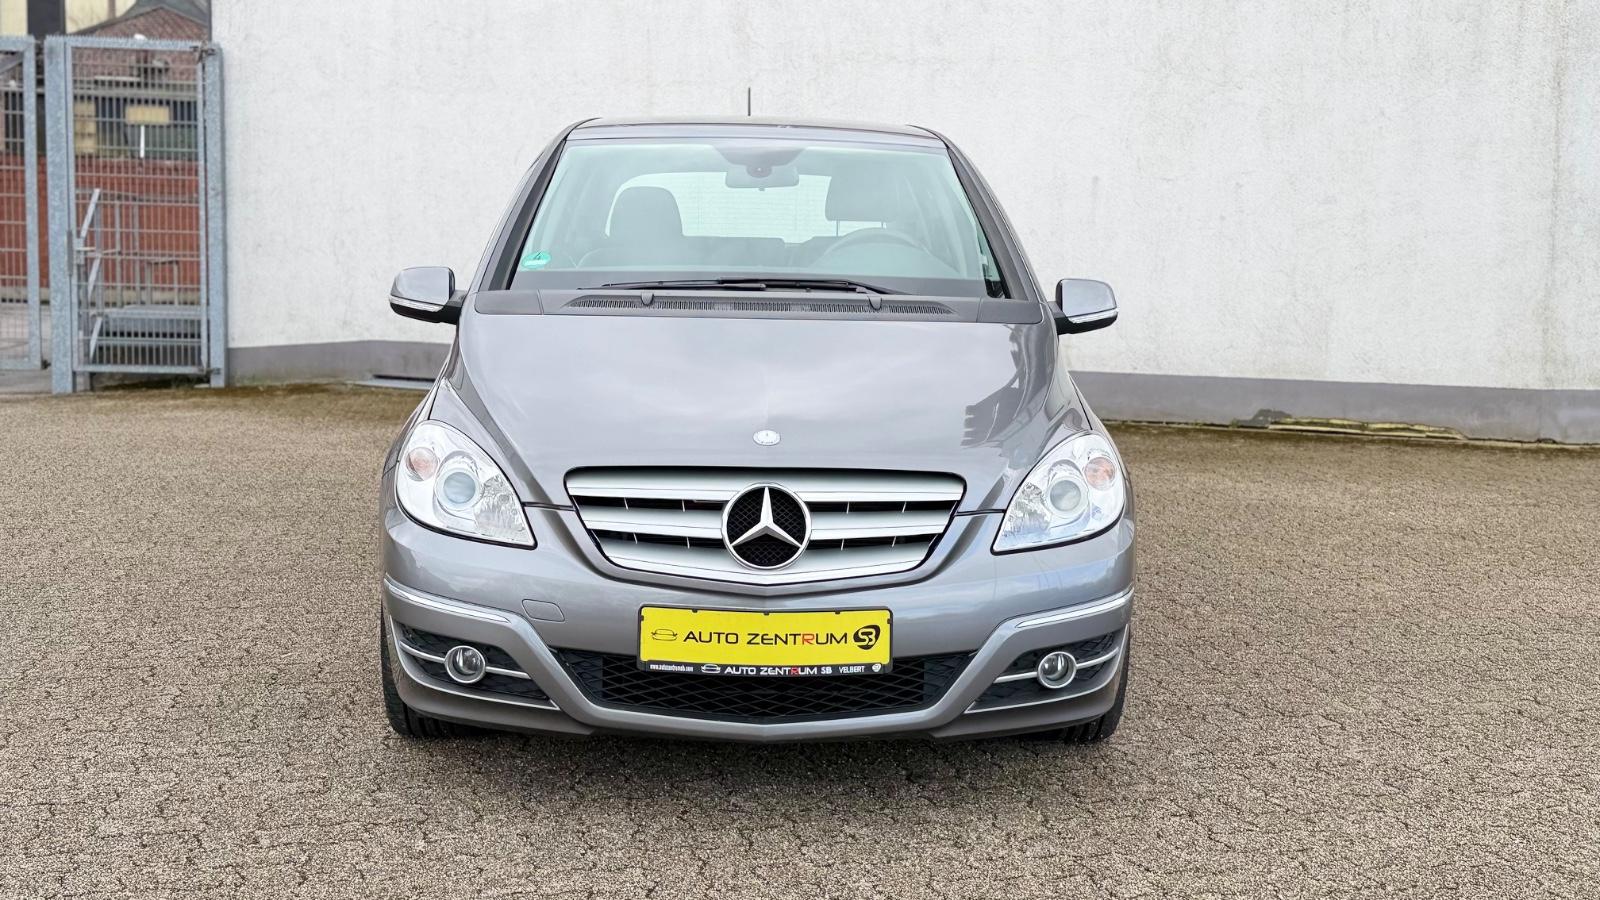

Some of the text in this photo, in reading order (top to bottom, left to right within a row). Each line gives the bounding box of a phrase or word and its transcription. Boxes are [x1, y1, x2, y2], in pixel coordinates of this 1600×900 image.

[683, 631, 738, 644] AUTO
[747, 633, 847, 646] ZENTRUM
[724, 666, 756, 675] AUTO
[760, 667, 817, 676] ZENTRUM
[821, 666, 832, 674] SB
[839, 665, 865, 674] VELBERT
